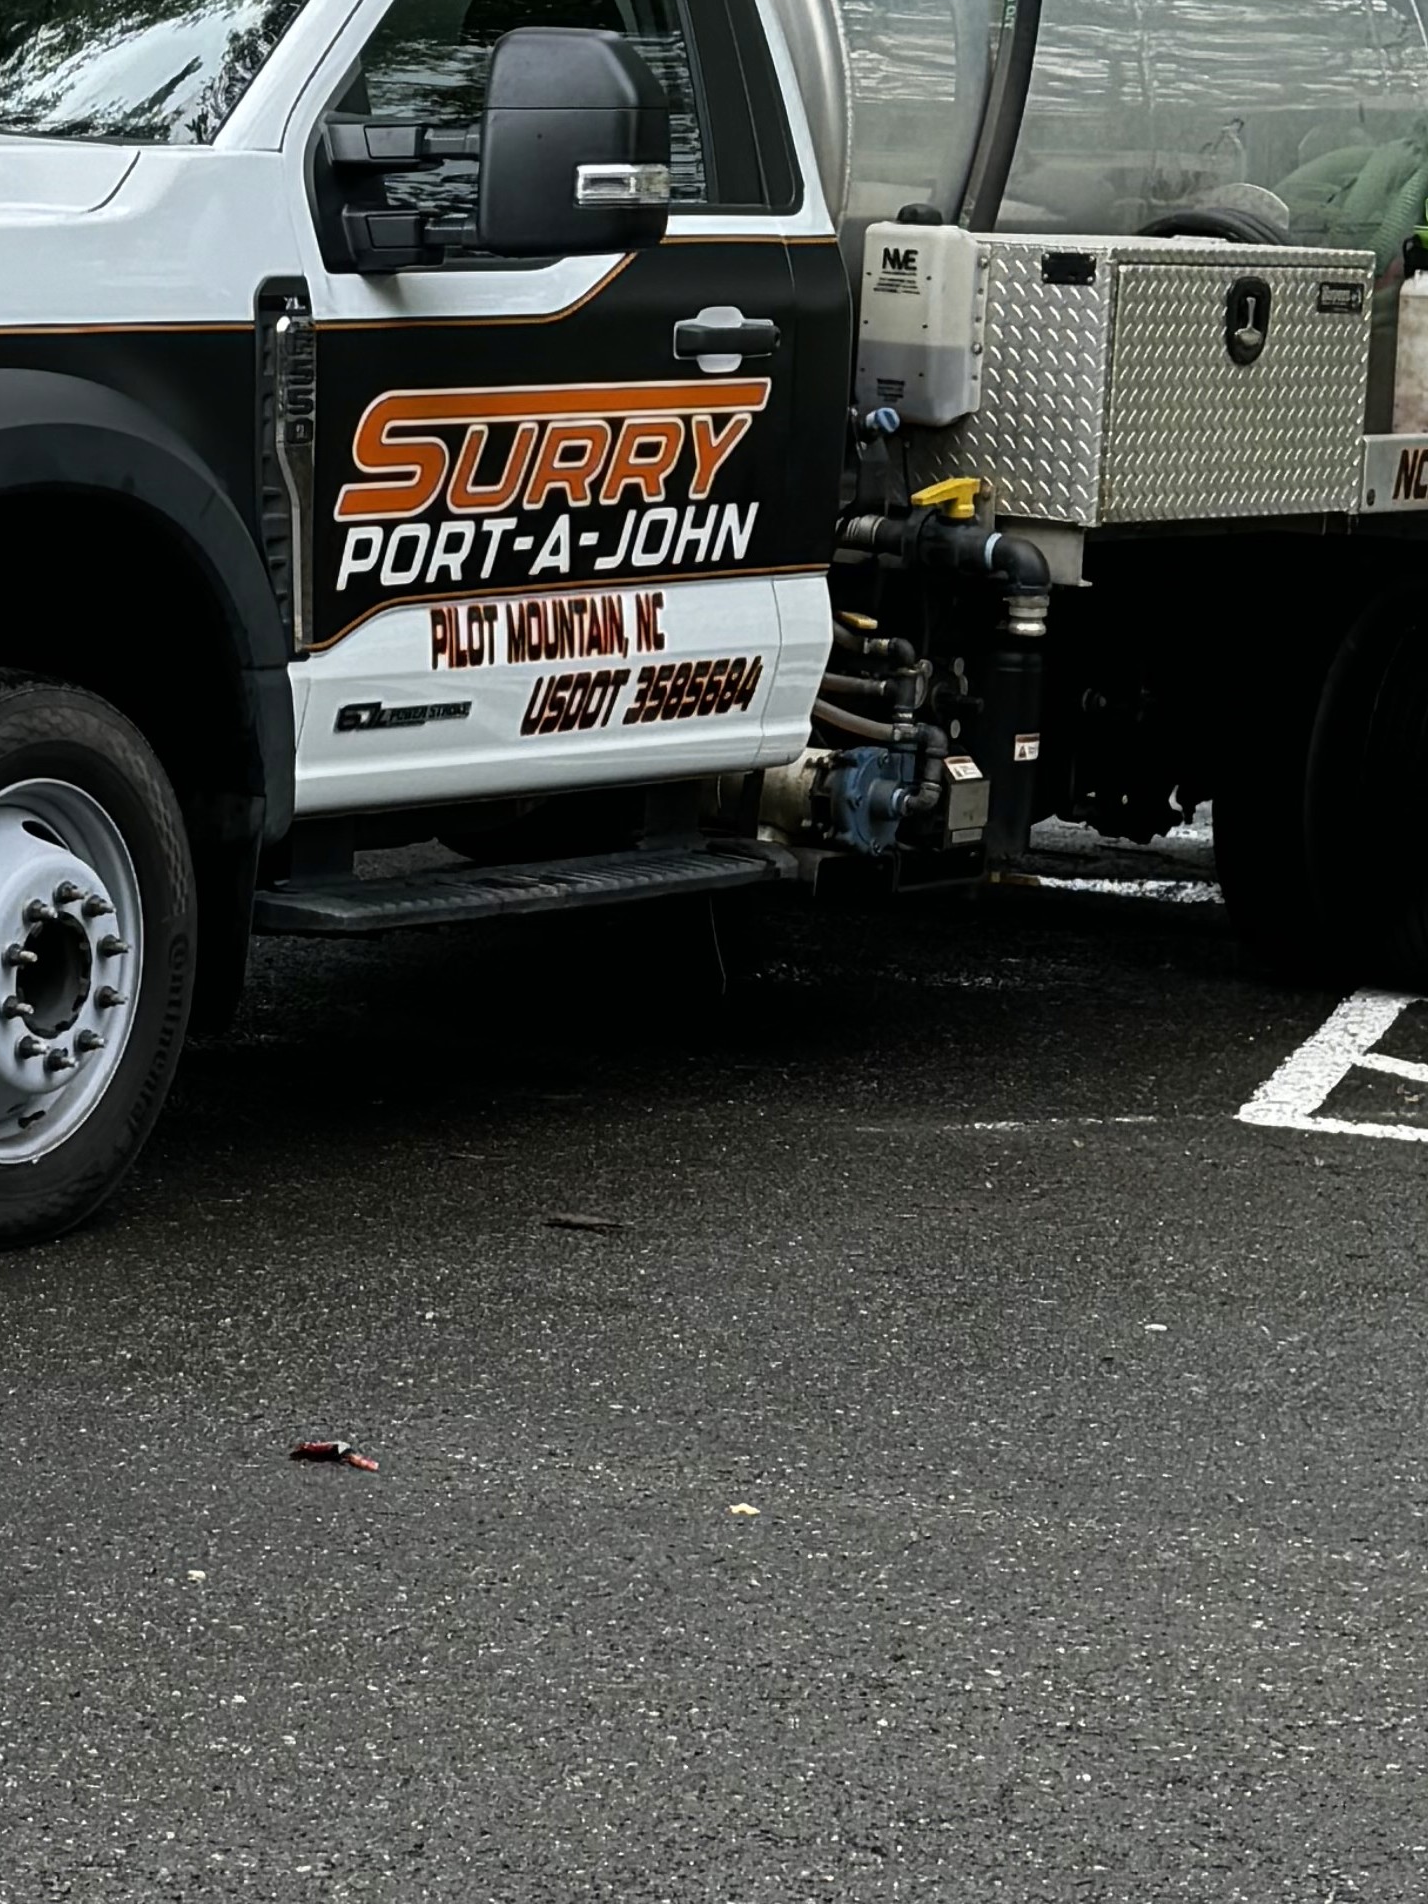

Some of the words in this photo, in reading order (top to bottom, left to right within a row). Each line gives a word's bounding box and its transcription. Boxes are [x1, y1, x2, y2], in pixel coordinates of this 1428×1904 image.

[882, 247, 919, 270] NVE
[334, 377, 771, 521] SURRY
[336, 502, 759, 591] PORT-A-JOHN
[430, 604, 498, 670] PILOT
[506, 594, 629, 659] MOUNTAIN,
[635, 591, 665, 652] NC
[520, 669, 631, 736] USDOT
[622, 655, 763, 725] 3585684
[125, 933, 189, 1133] Continental
